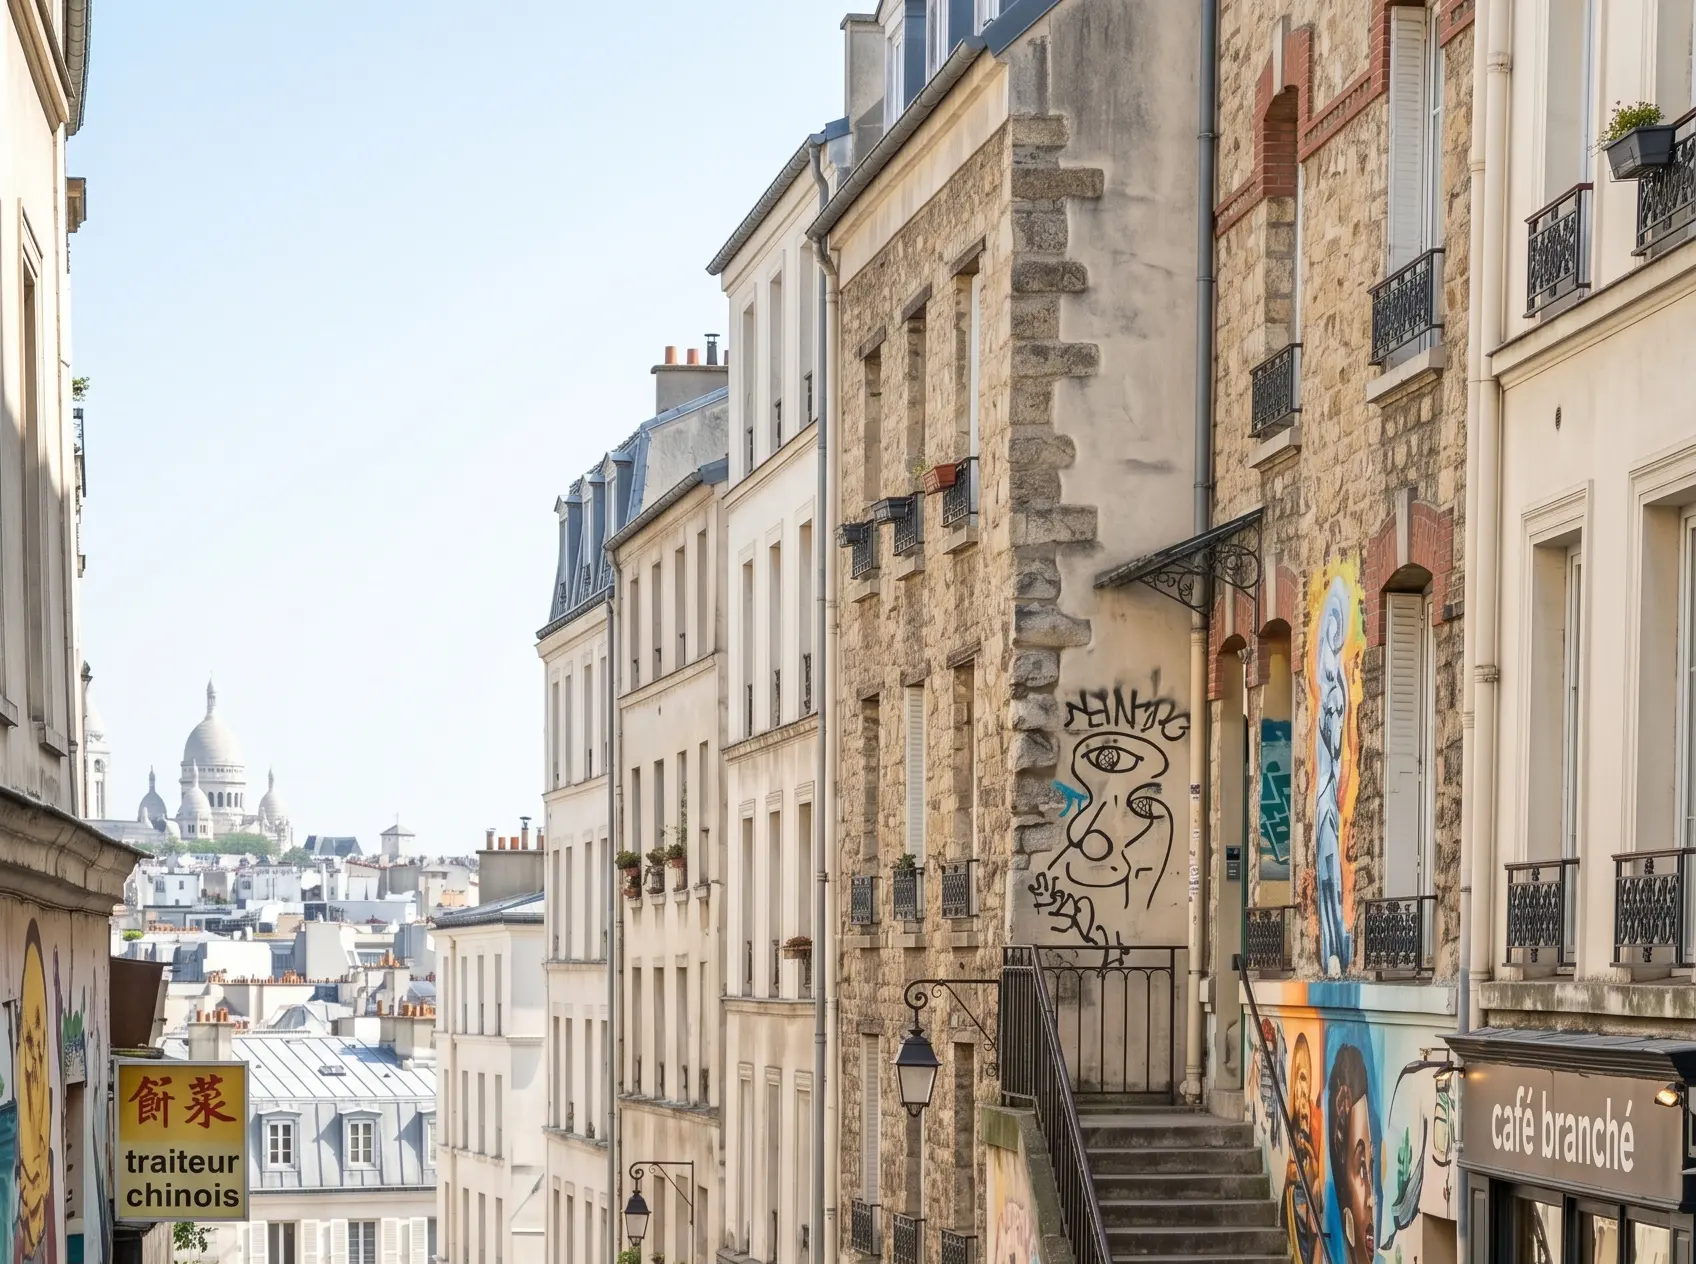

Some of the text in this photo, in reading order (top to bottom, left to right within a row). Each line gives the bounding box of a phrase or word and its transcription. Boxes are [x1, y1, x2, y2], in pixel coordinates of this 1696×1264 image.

[1491, 1085, 1635, 1173] café branché
[125, 1149, 240, 1174] traiteur
[126, 1182, 240, 1208] chinois
